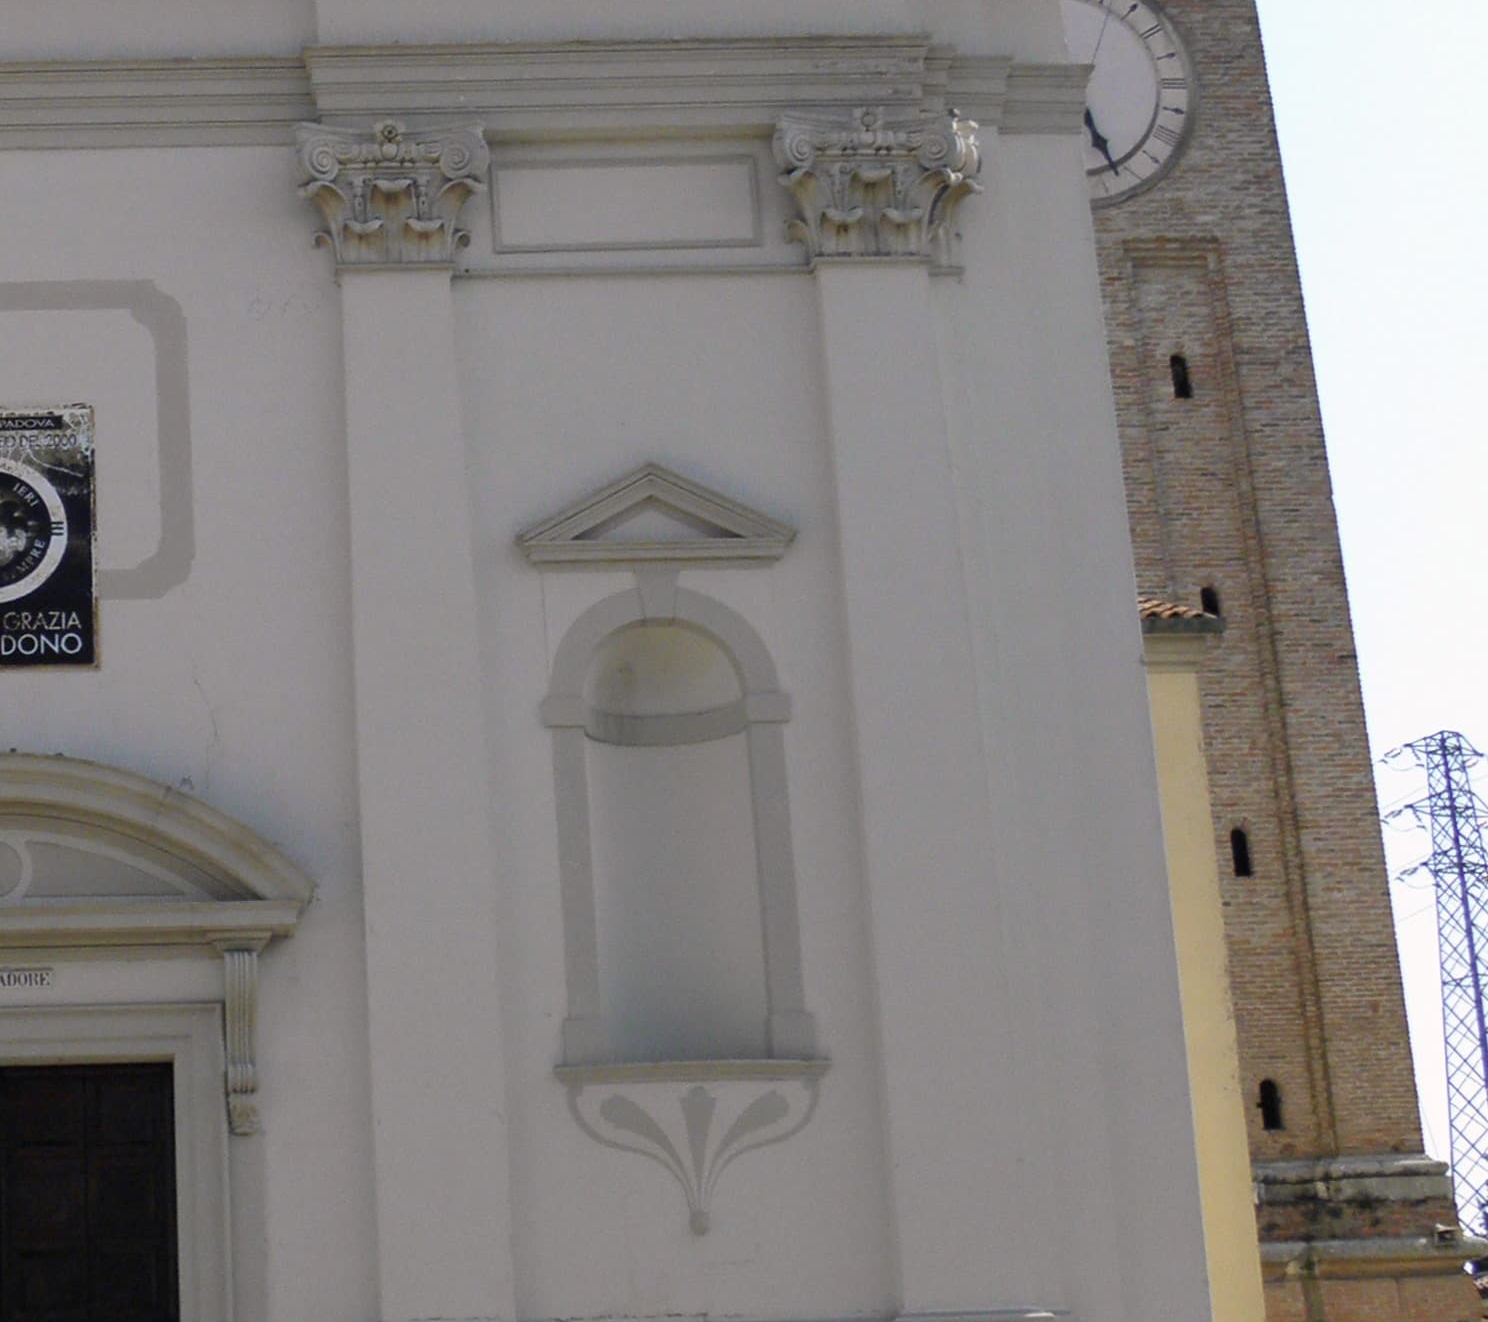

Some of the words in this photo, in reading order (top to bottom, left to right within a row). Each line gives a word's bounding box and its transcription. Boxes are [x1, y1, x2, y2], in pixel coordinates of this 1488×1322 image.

[0, 417, 56, 429] PADOVA
[19, 434, 42, 448] DEL
[47, 432, 78, 448] 2000
[12, 481, 40, 508] IERI
[3, 611, 82, 631] GRAZIA
